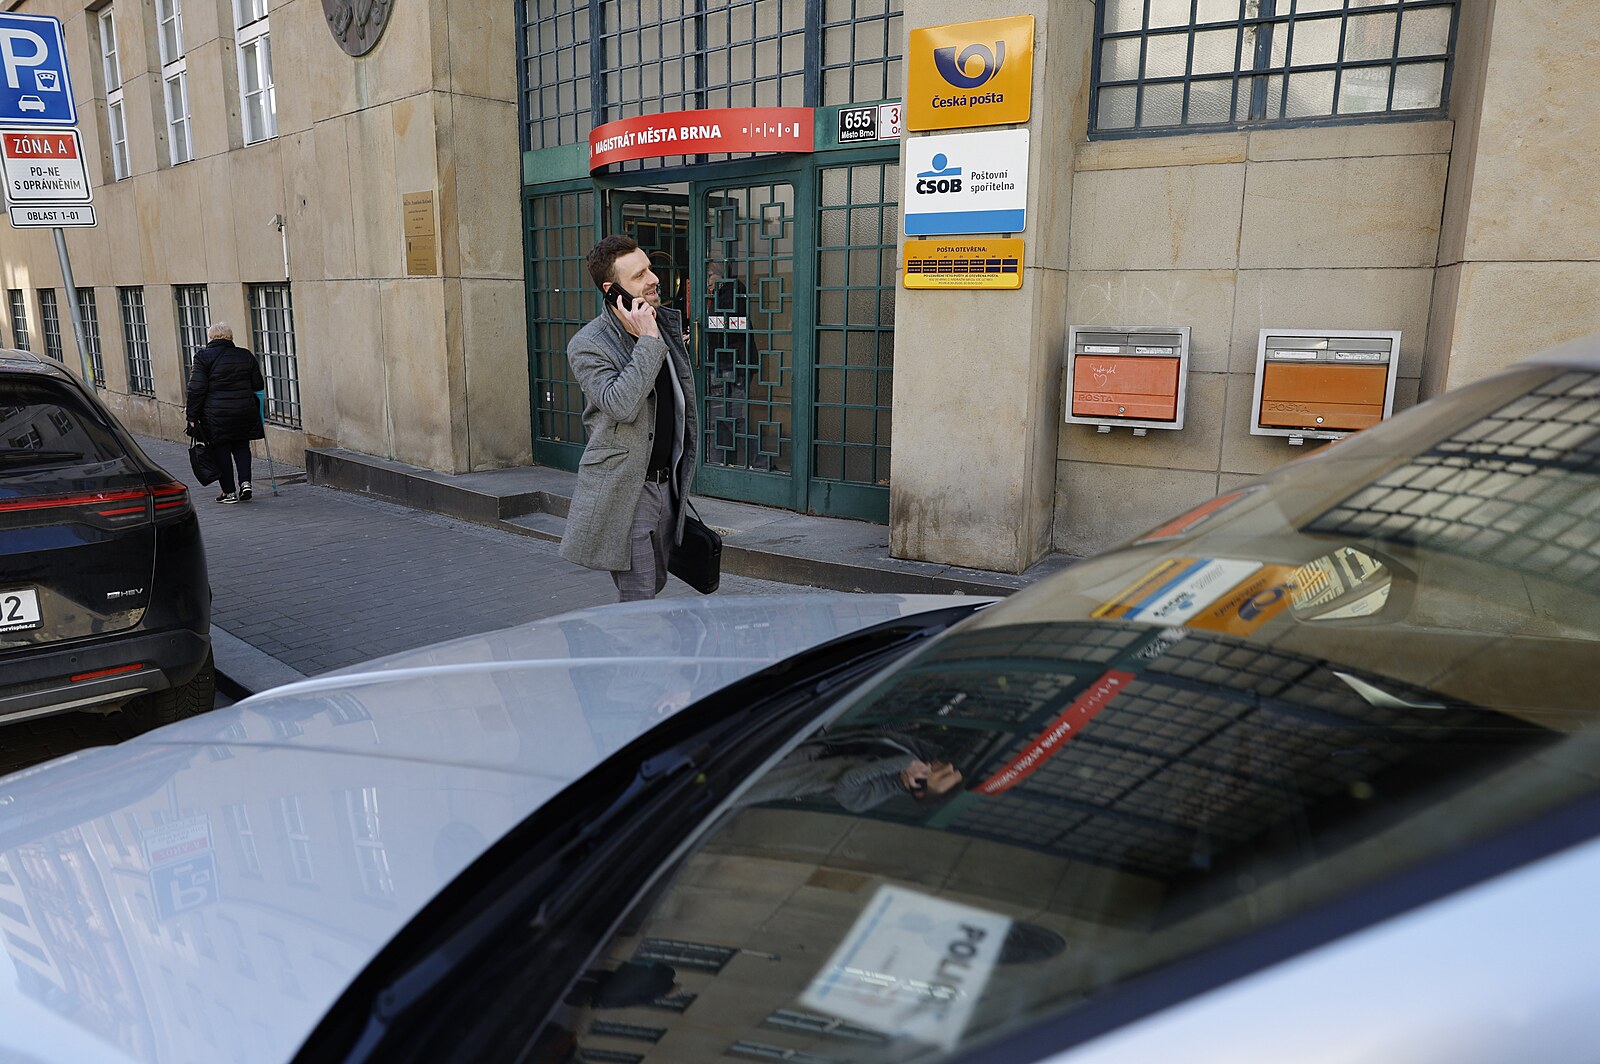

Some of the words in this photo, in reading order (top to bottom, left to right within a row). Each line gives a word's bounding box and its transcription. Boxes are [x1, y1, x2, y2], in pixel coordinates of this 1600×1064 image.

[0, 28, 48, 88] P
[932, 95, 967, 108] Česká
[969, 93, 1004, 107] pošta
[845, 110, 871, 129] 655
[595, 131, 635, 155] MAGISTRÁT
[637, 127, 678, 145] MĚSTA
[680, 124, 722, 140] BRNA
[841, 130, 859, 139] Město
[859, 129, 874, 138] Brno
[13, 135, 53, 154] ZÓNA
[58, 139, 68, 154] A
[30, 166, 61, 177] PO-NE
[971, 169, 1008, 180] Poštovní
[14, 180, 21, 190] S
[23, 178, 81, 190] OPRÁVNĚNÍM
[916, 178, 962, 194] ČSOB
[970, 181, 1015, 194] spořitelna
[27, 211, 57, 220] OBLAST
[61, 211, 80, 220] 1-01
[0, 596, 23, 621] 2
